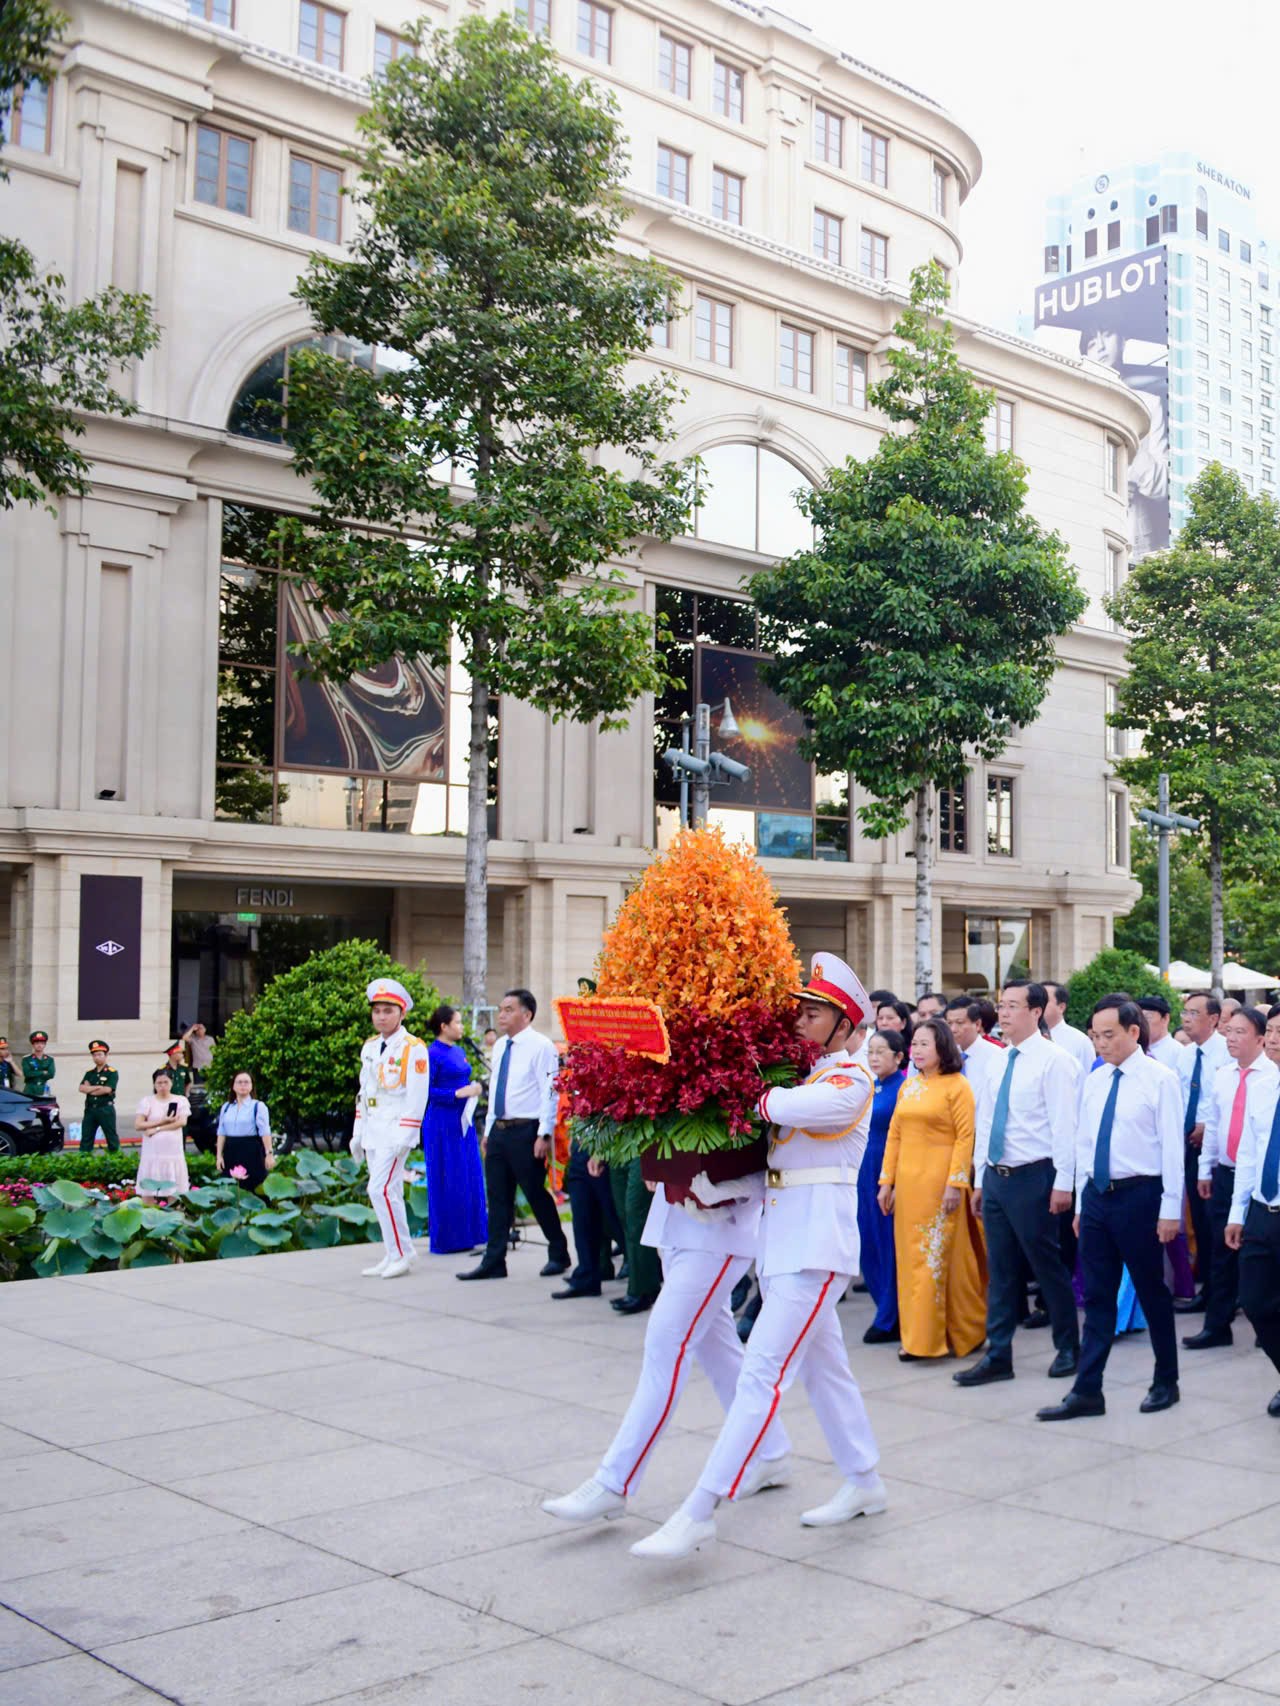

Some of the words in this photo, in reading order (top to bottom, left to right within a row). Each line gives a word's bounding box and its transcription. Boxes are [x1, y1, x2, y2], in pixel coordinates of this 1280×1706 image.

[1196, 161, 1251, 200] SHERATON
[1038, 254, 1162, 321] HUBLOT
[237, 888, 294, 906] FENDI
